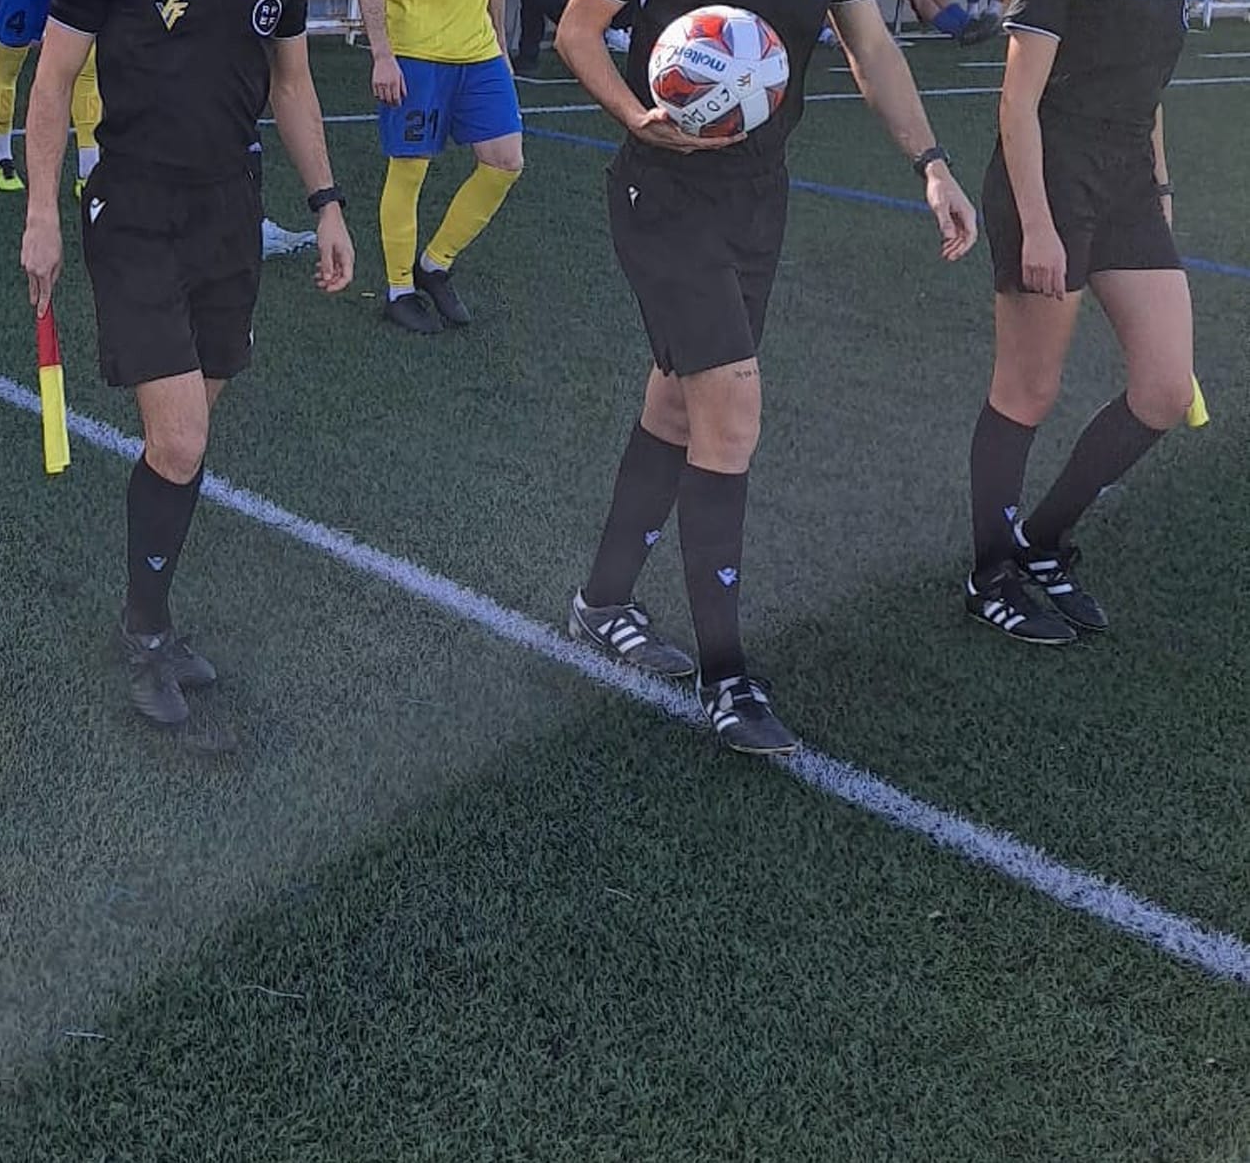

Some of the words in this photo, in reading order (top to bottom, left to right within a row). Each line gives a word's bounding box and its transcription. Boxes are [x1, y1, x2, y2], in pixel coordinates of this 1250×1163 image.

[5, 9, 26, 38] 4
[678, 45, 727, 73] molten
[404, 108, 440, 142] 21
